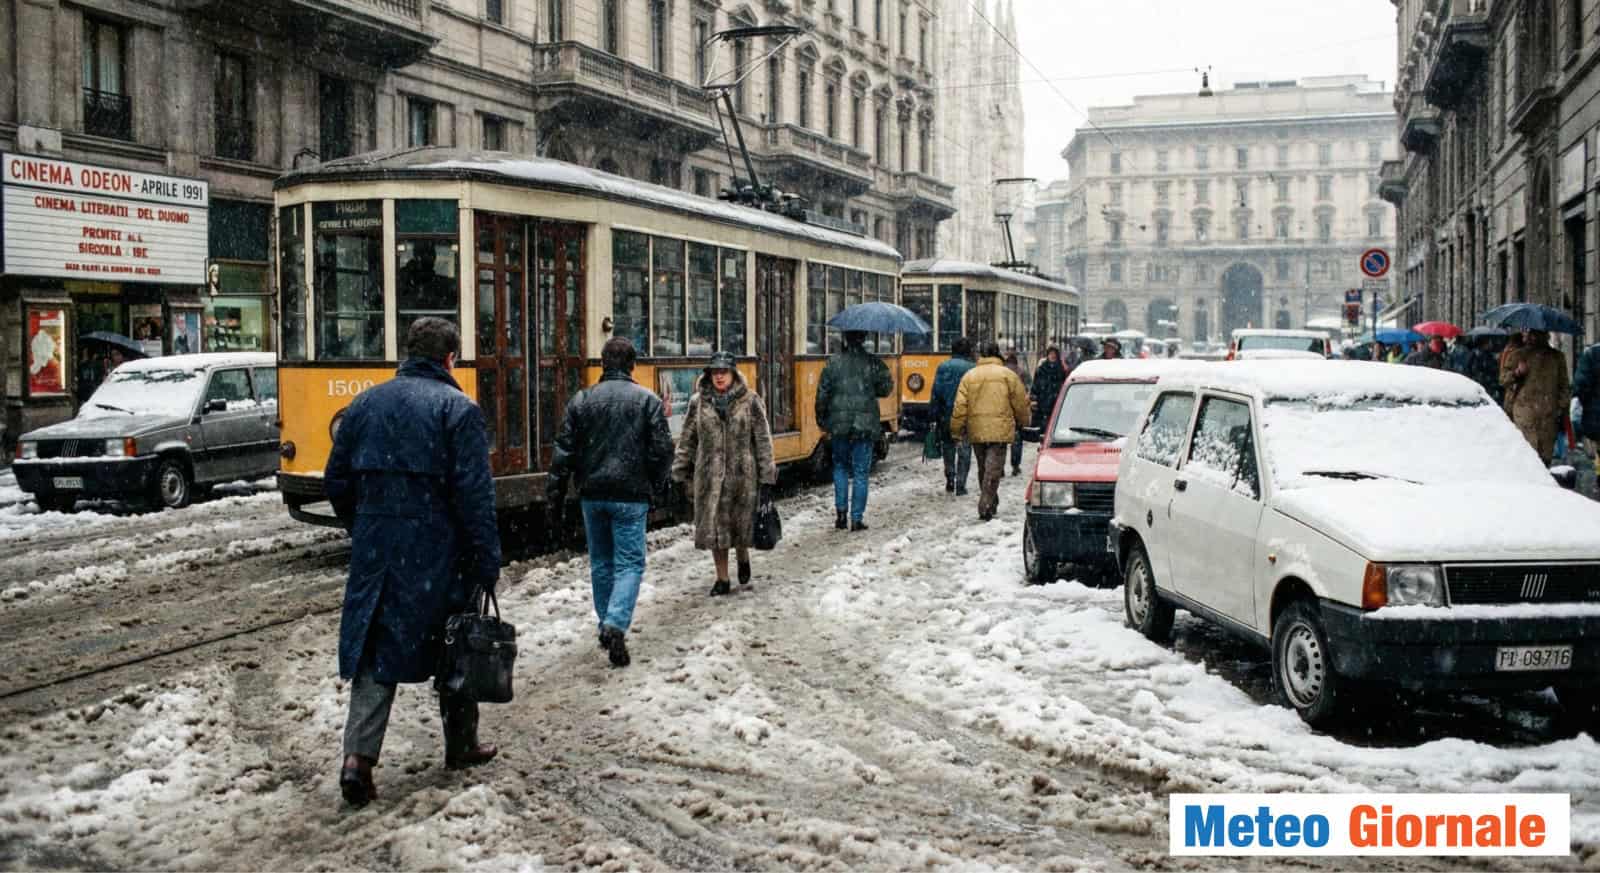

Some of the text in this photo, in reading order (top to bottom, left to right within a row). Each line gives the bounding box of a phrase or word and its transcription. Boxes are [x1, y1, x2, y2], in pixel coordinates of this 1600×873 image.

[10, 159, 74, 186] CINEMA
[80, 168, 132, 193] ODEON
[140, 178, 178, 198] APRILE
[182, 185, 204, 201] 1991
[34, 196, 76, 212] CINEMA
[137, 207, 154, 220] DEL
[1522, 650, 1570, 667] 09716
